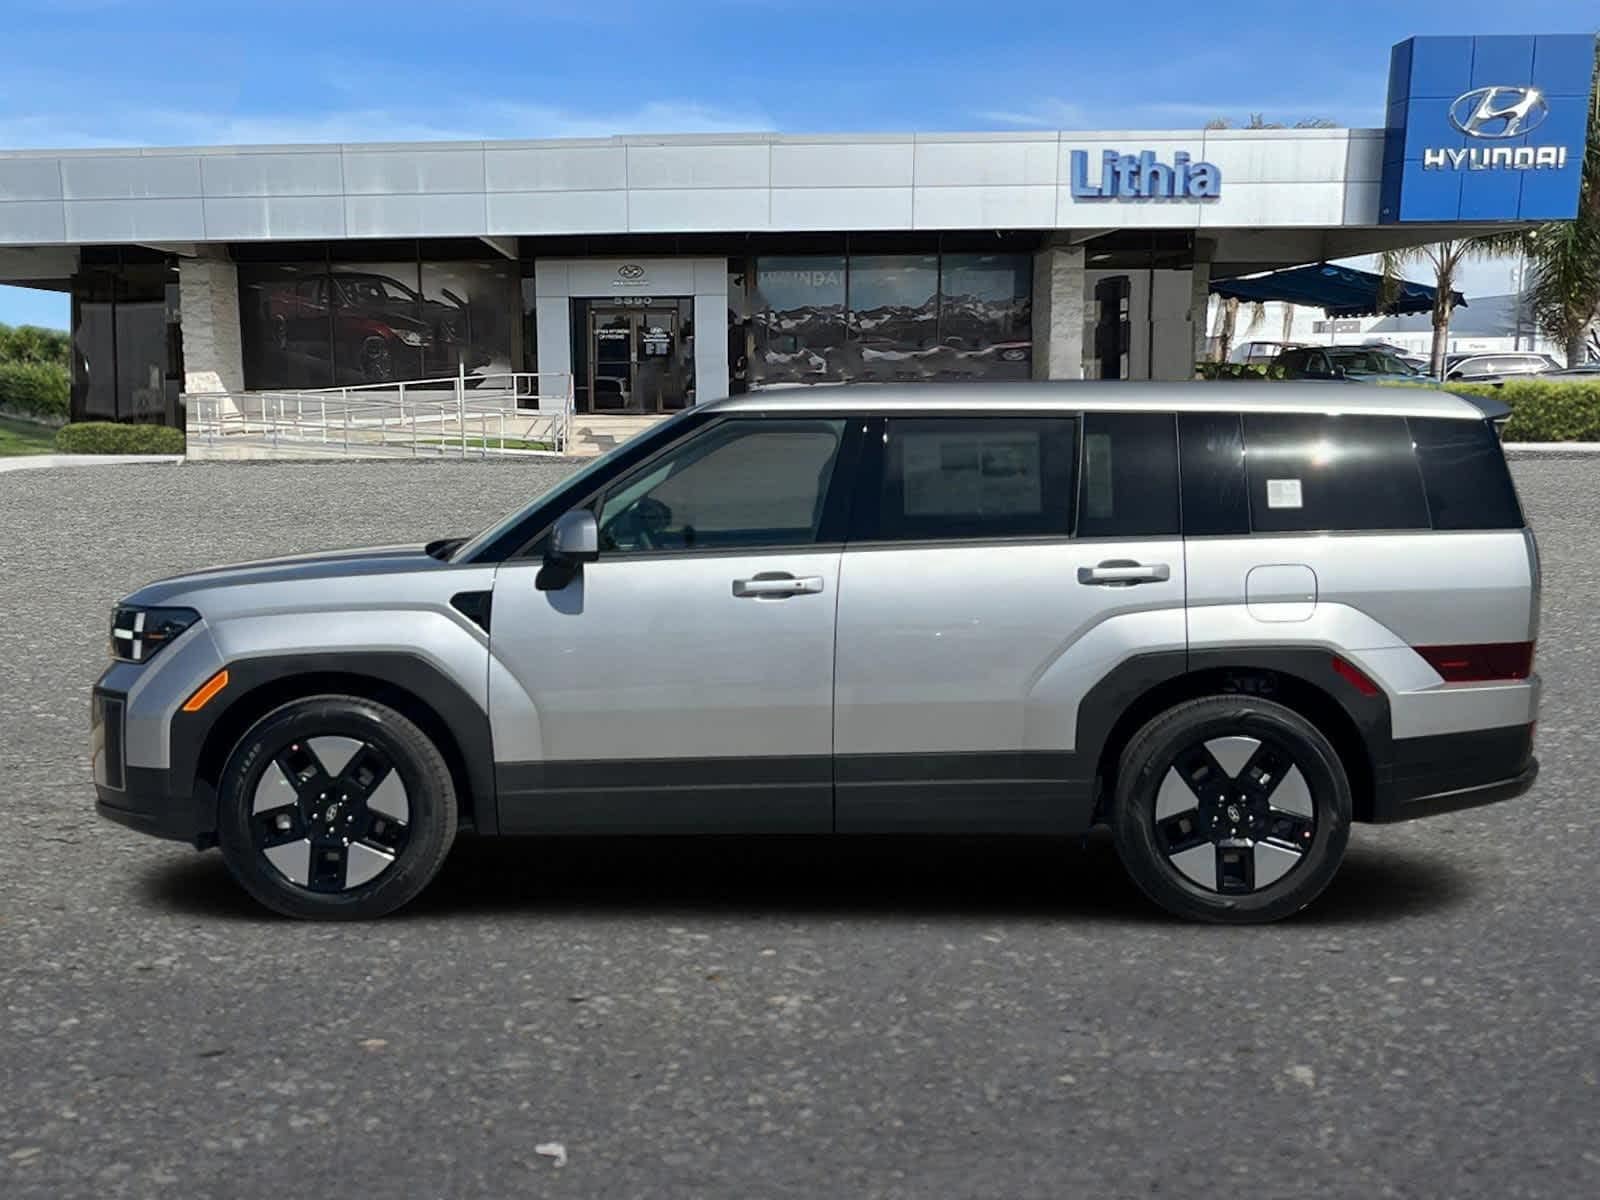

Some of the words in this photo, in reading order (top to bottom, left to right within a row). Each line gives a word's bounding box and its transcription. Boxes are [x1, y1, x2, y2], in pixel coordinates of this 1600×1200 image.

[1424, 147, 1567, 170] HYUNDAI
[1071, 150, 1221, 200] Lithia
[759, 271, 842, 287] NDAI
